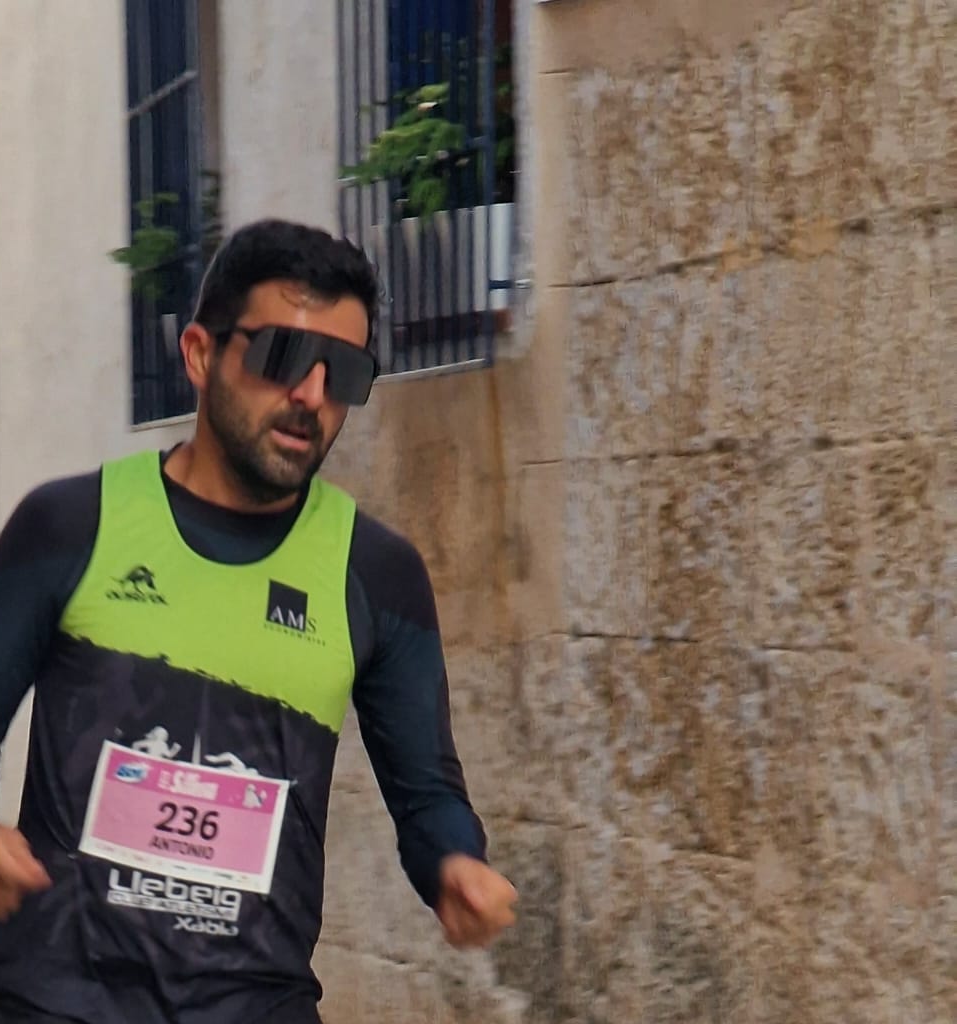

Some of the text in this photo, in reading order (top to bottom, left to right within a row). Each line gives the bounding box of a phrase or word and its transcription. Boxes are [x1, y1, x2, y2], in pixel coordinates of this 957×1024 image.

[269, 604, 317, 633] AMS
[154, 802, 220, 841] 236
[149, 836, 215, 860] ANTONIO
